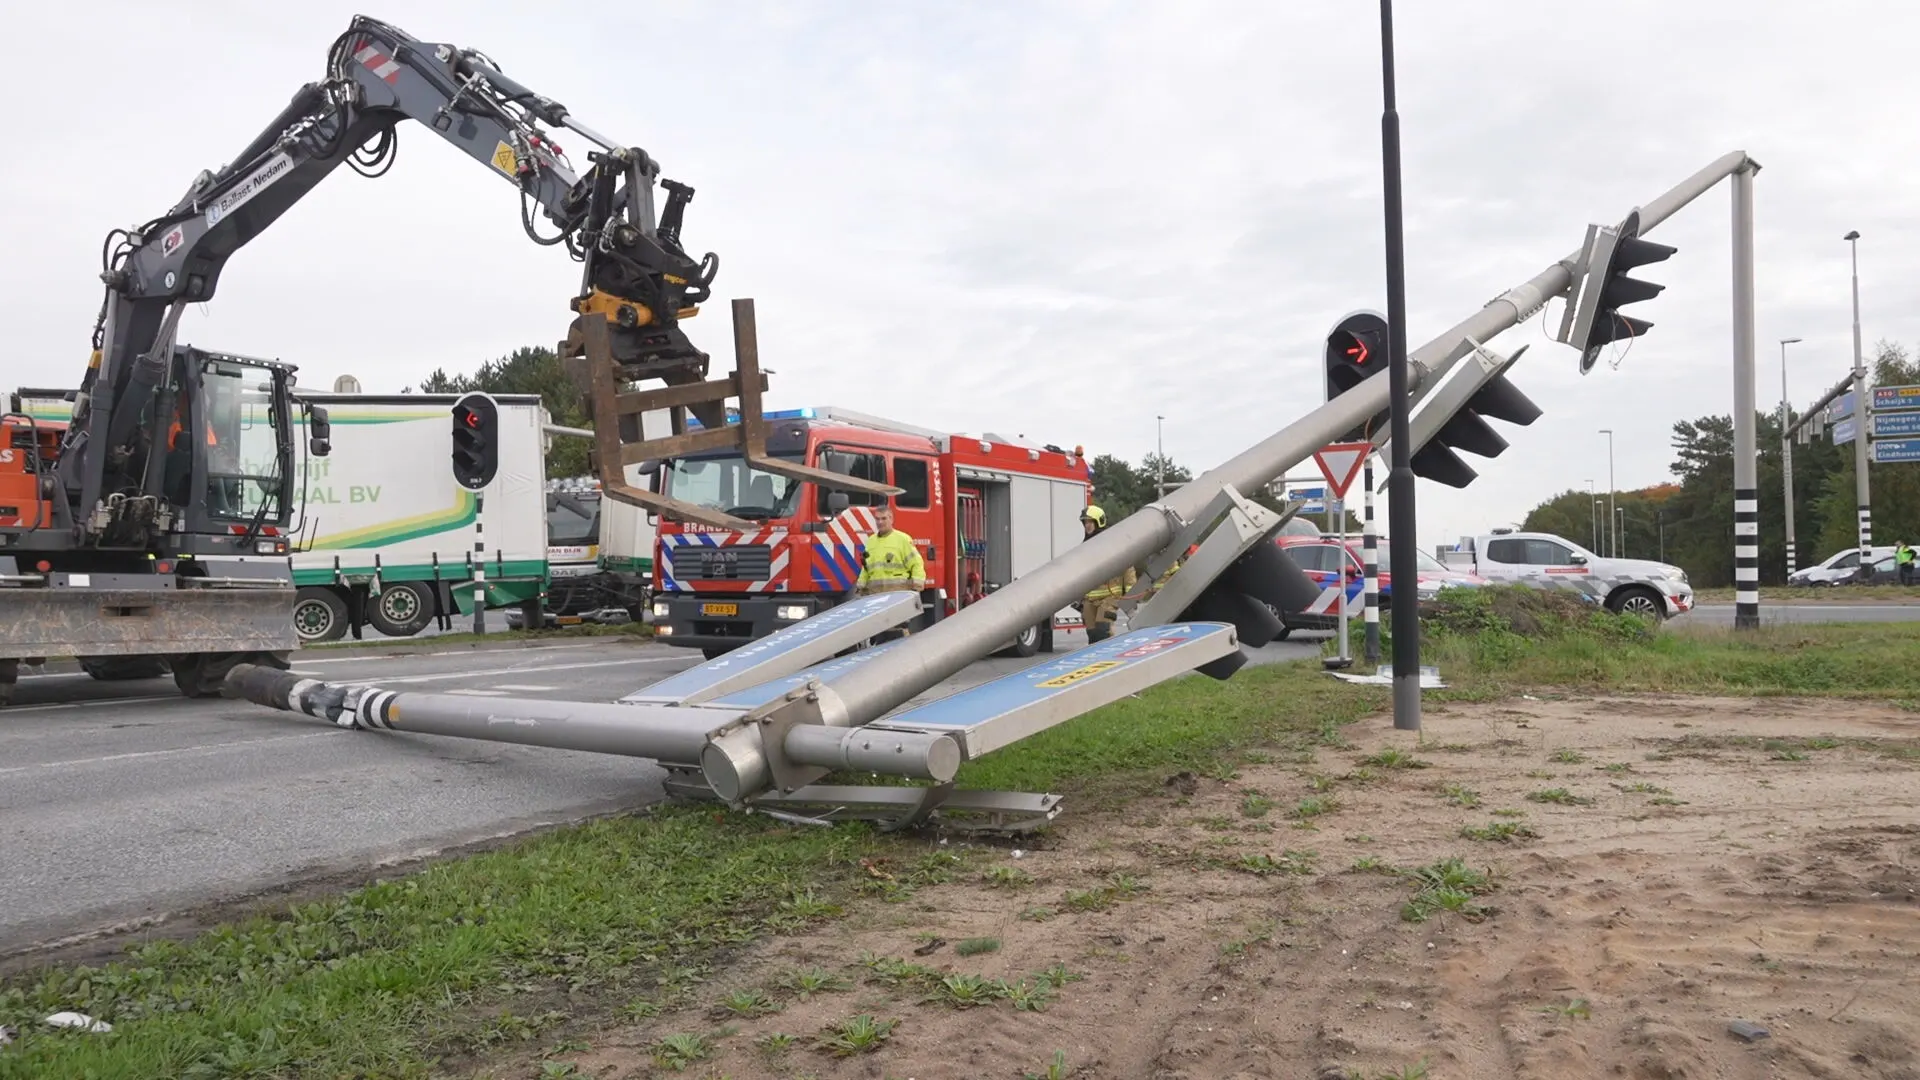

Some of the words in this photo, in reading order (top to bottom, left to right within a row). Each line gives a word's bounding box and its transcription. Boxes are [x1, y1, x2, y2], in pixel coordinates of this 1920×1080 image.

[220, 184, 253, 212] Ballast
[253, 159, 288, 188] Nedam
[349, 486, 381, 504] BV
[1048, 637, 1149, 671] Schaijk
[1123, 639, 1173, 657] A50
[1048, 661, 1118, 685] N324
